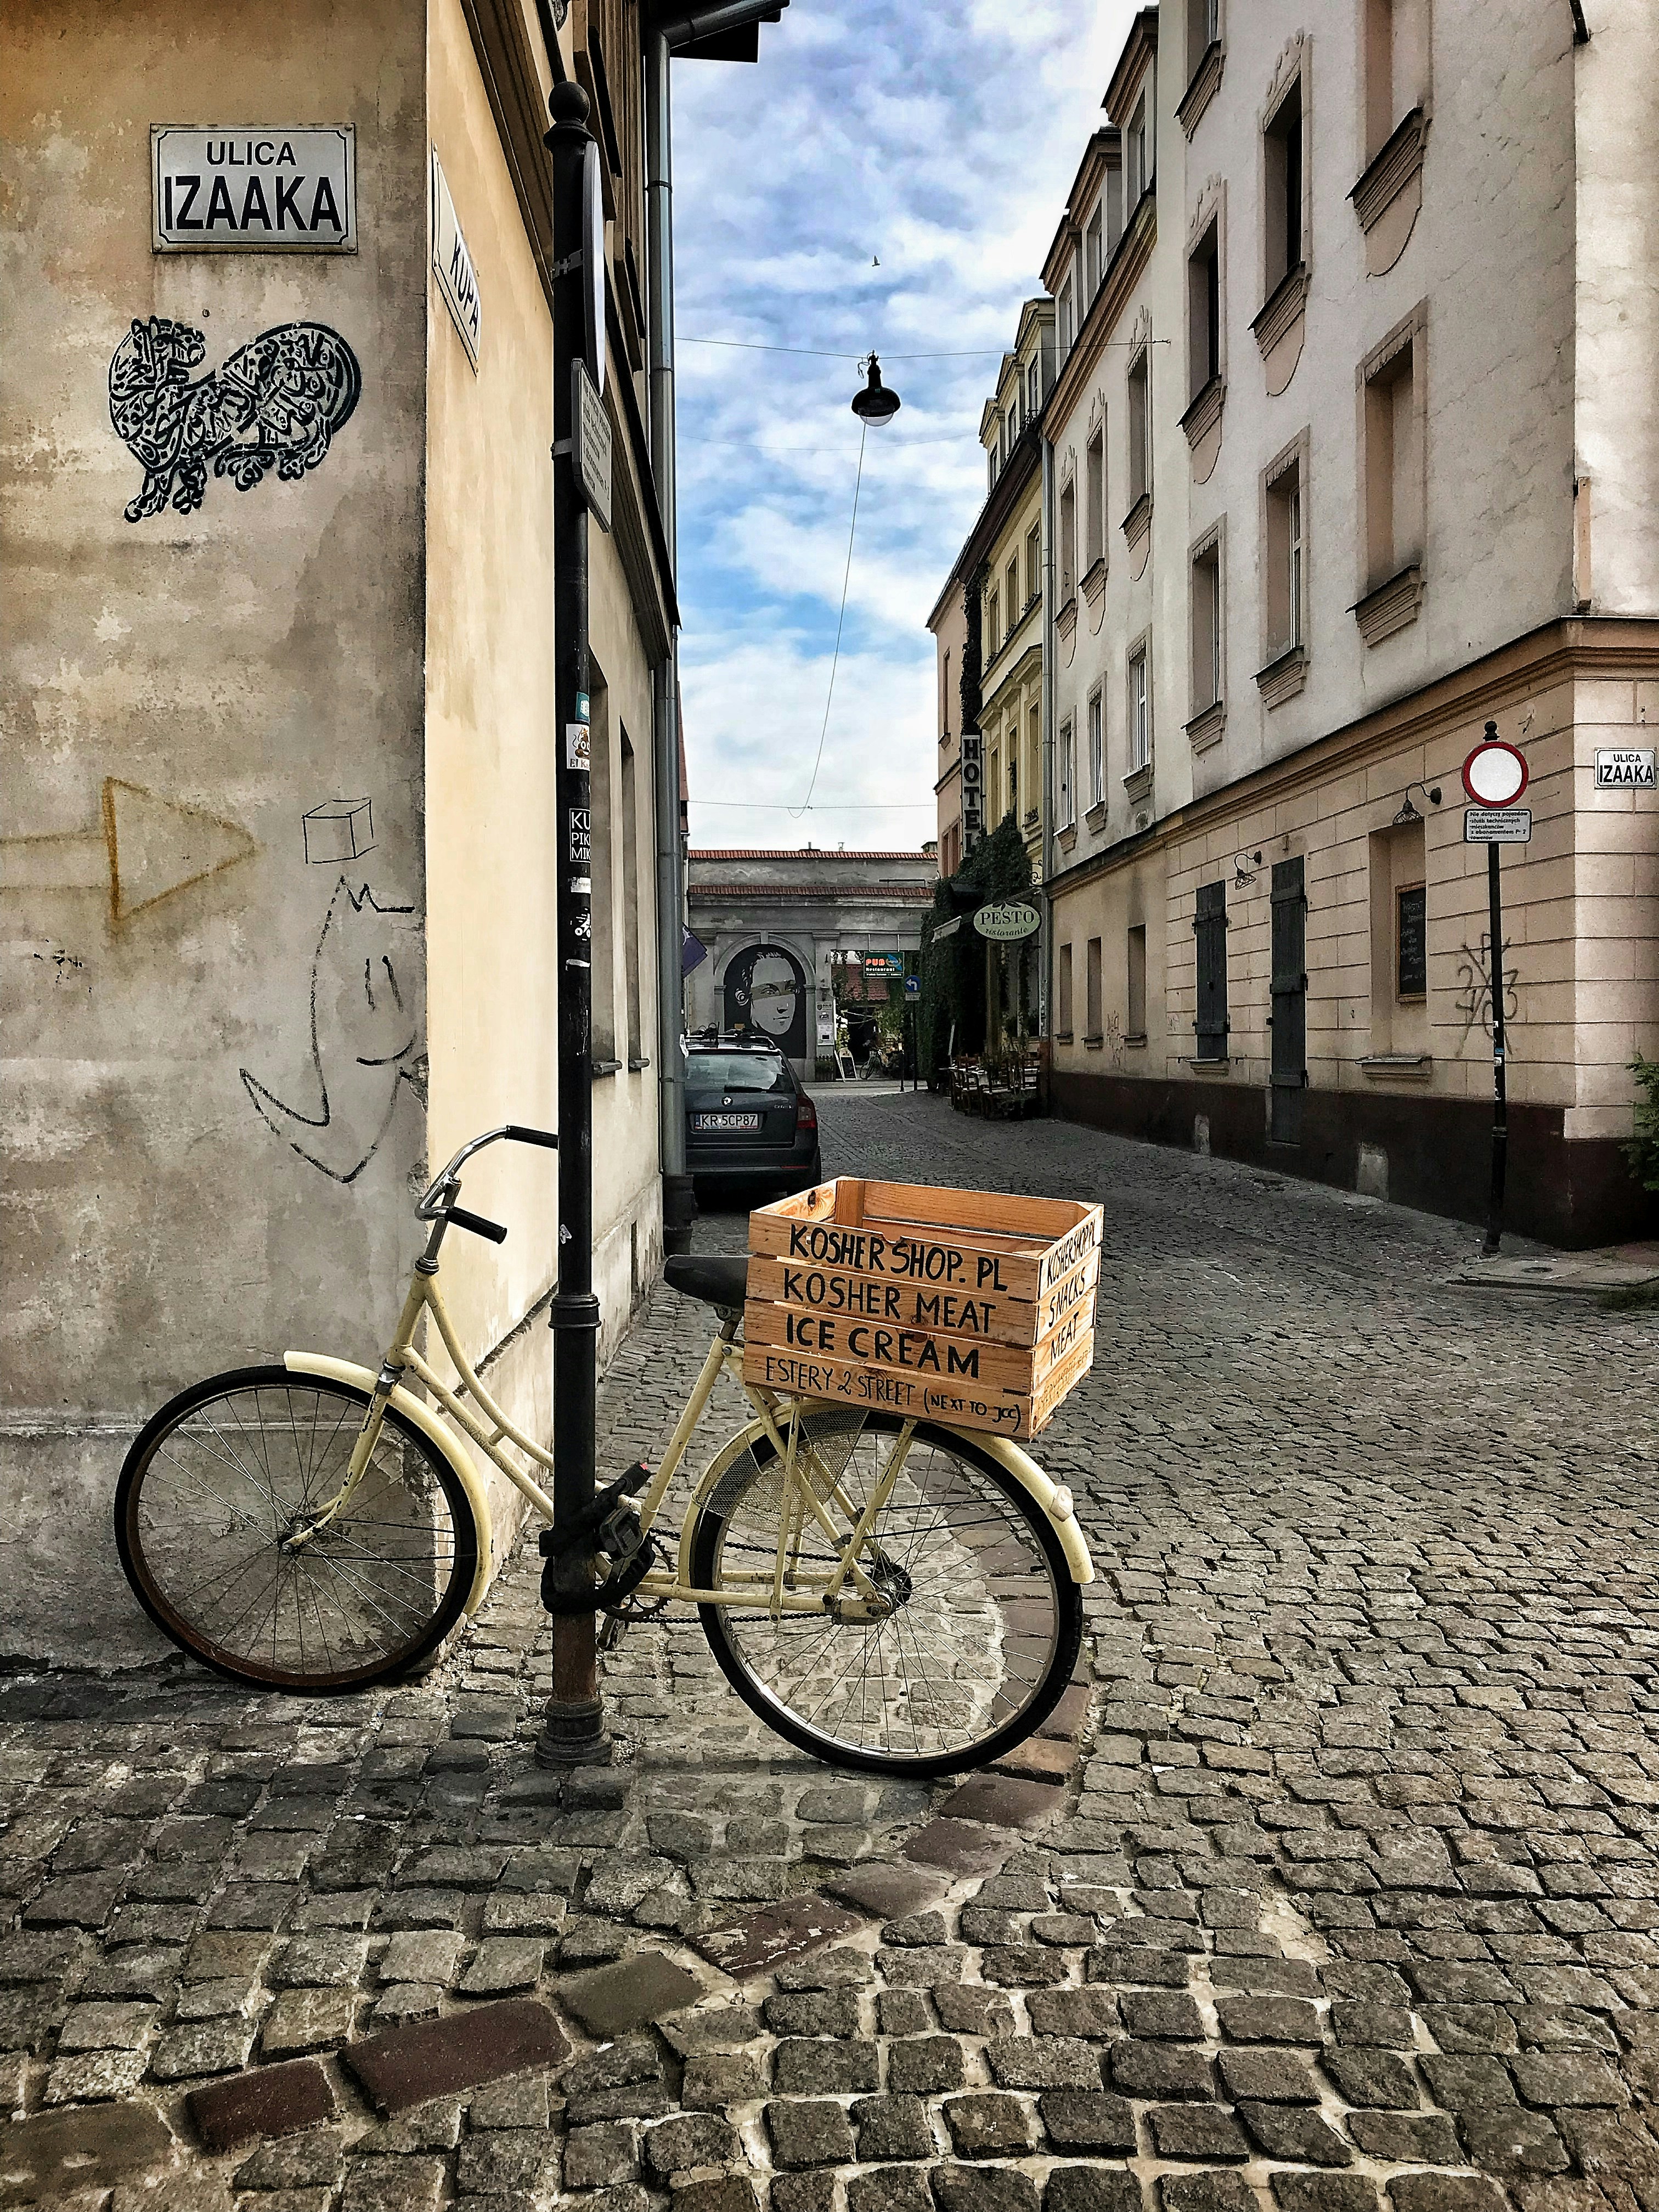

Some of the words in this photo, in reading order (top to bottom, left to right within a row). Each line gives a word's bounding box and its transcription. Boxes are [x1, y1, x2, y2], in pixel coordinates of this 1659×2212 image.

[207, 141, 297, 166] ULICA
[165, 176, 343, 232] IZAAKA
[449, 231, 479, 338] KUPA
[1599, 765, 1654, 783] IZAAKA
[1613, 754, 1641, 763] ULICA
[963, 739, 980, 853] HOTEL
[980, 911, 1035, 925] PESTO
[985, 927, 1028, 936] ristorante
[702, 1115, 719, 1126] KR
[722, 1115, 756, 1126] 5CP87
[784, 1268, 901, 1320] KOSHER
[916, 1292, 996, 1333] MEAT
[1048, 1266, 1086, 1328] SNACKS
[786, 1313, 836, 1351] ICE
[848, 1327, 979, 1379] CREAM
[1050, 1311, 1079, 1367] MEAT
[765, 1356, 834, 1391] ESTERY
[837, 1370, 851, 1396] 2
[858, 1375, 916, 1406] STREET
[924, 1387, 966, 1414] (NEXT
[969, 1401, 988, 1415] TO
[991, 1403, 1022, 1432] JCC)
